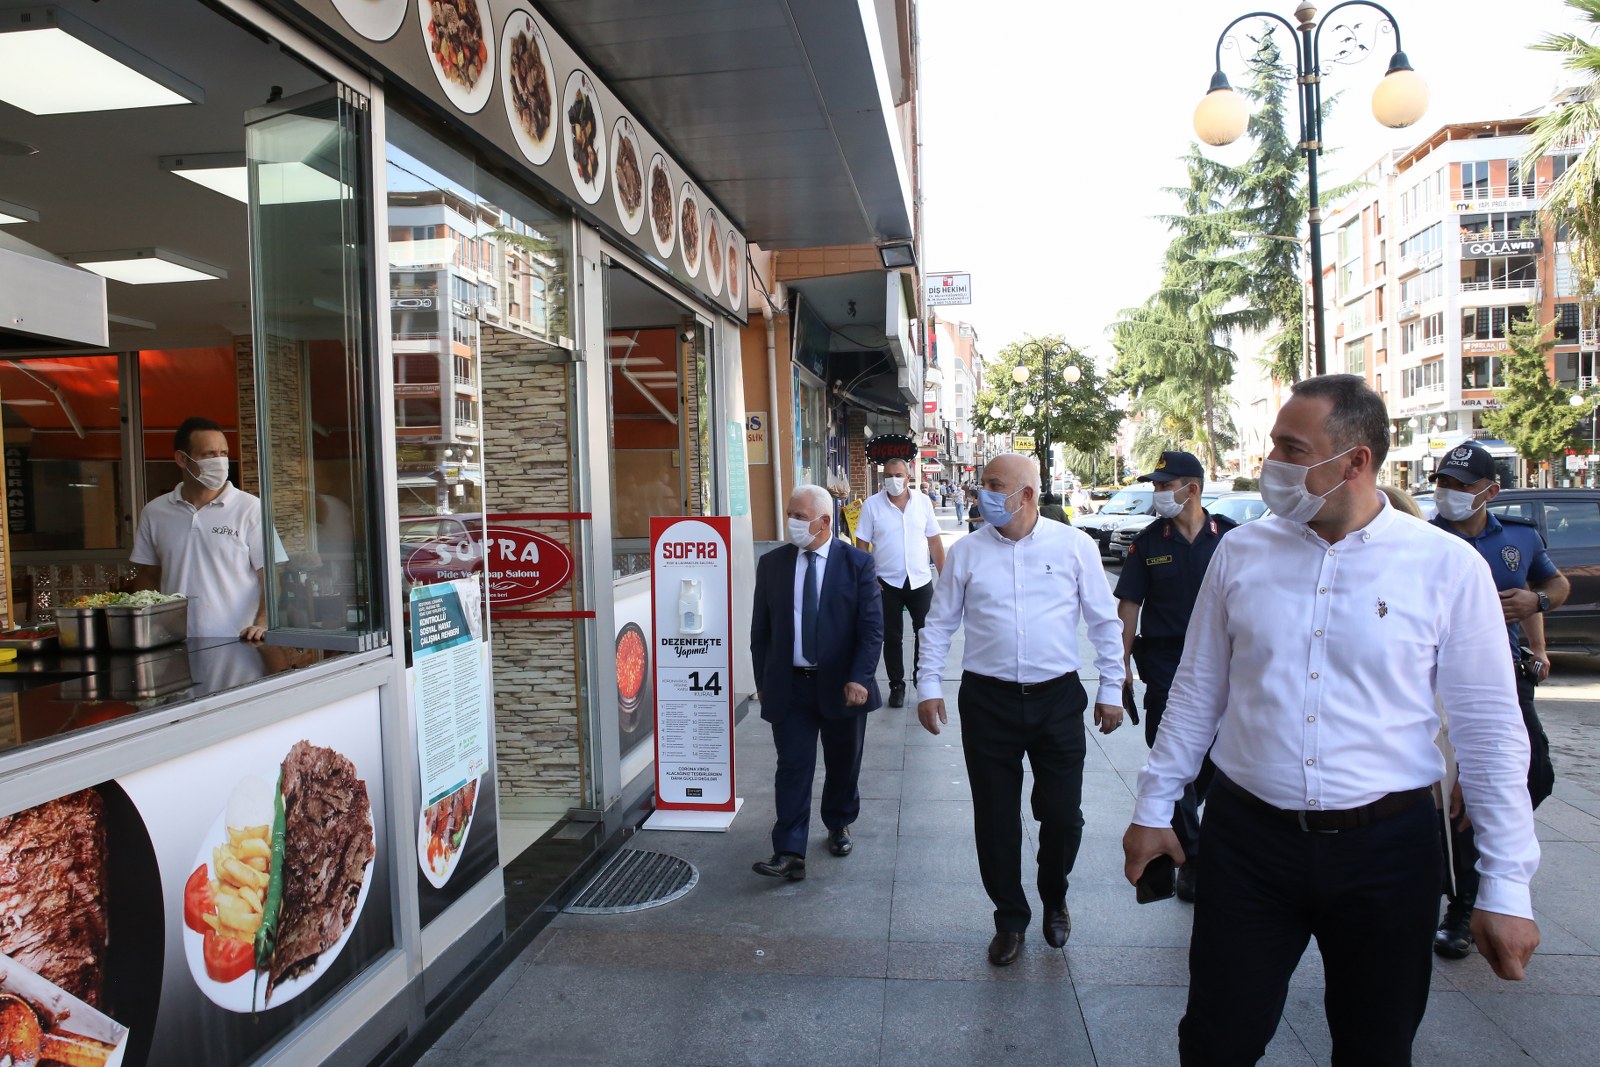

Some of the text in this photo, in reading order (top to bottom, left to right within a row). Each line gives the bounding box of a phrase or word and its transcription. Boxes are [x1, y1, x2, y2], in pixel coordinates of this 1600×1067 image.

[928, 284, 967, 294] DİŞ HEKİMİ
[211, 526, 239, 537] SOFRA
[435, 538, 540, 565] SOFRA
[437, 569, 459, 579] Pide
[505, 569, 540, 578] Salonu
[419, 612, 447, 627] KONTROLLÜ
[420, 620, 452, 636] SOSYAL HAYAT
[420, 633, 441, 648] ÇALIŞMA
[661, 638, 722, 647] DEZENFEKTE
[688, 671, 722, 696] 14
